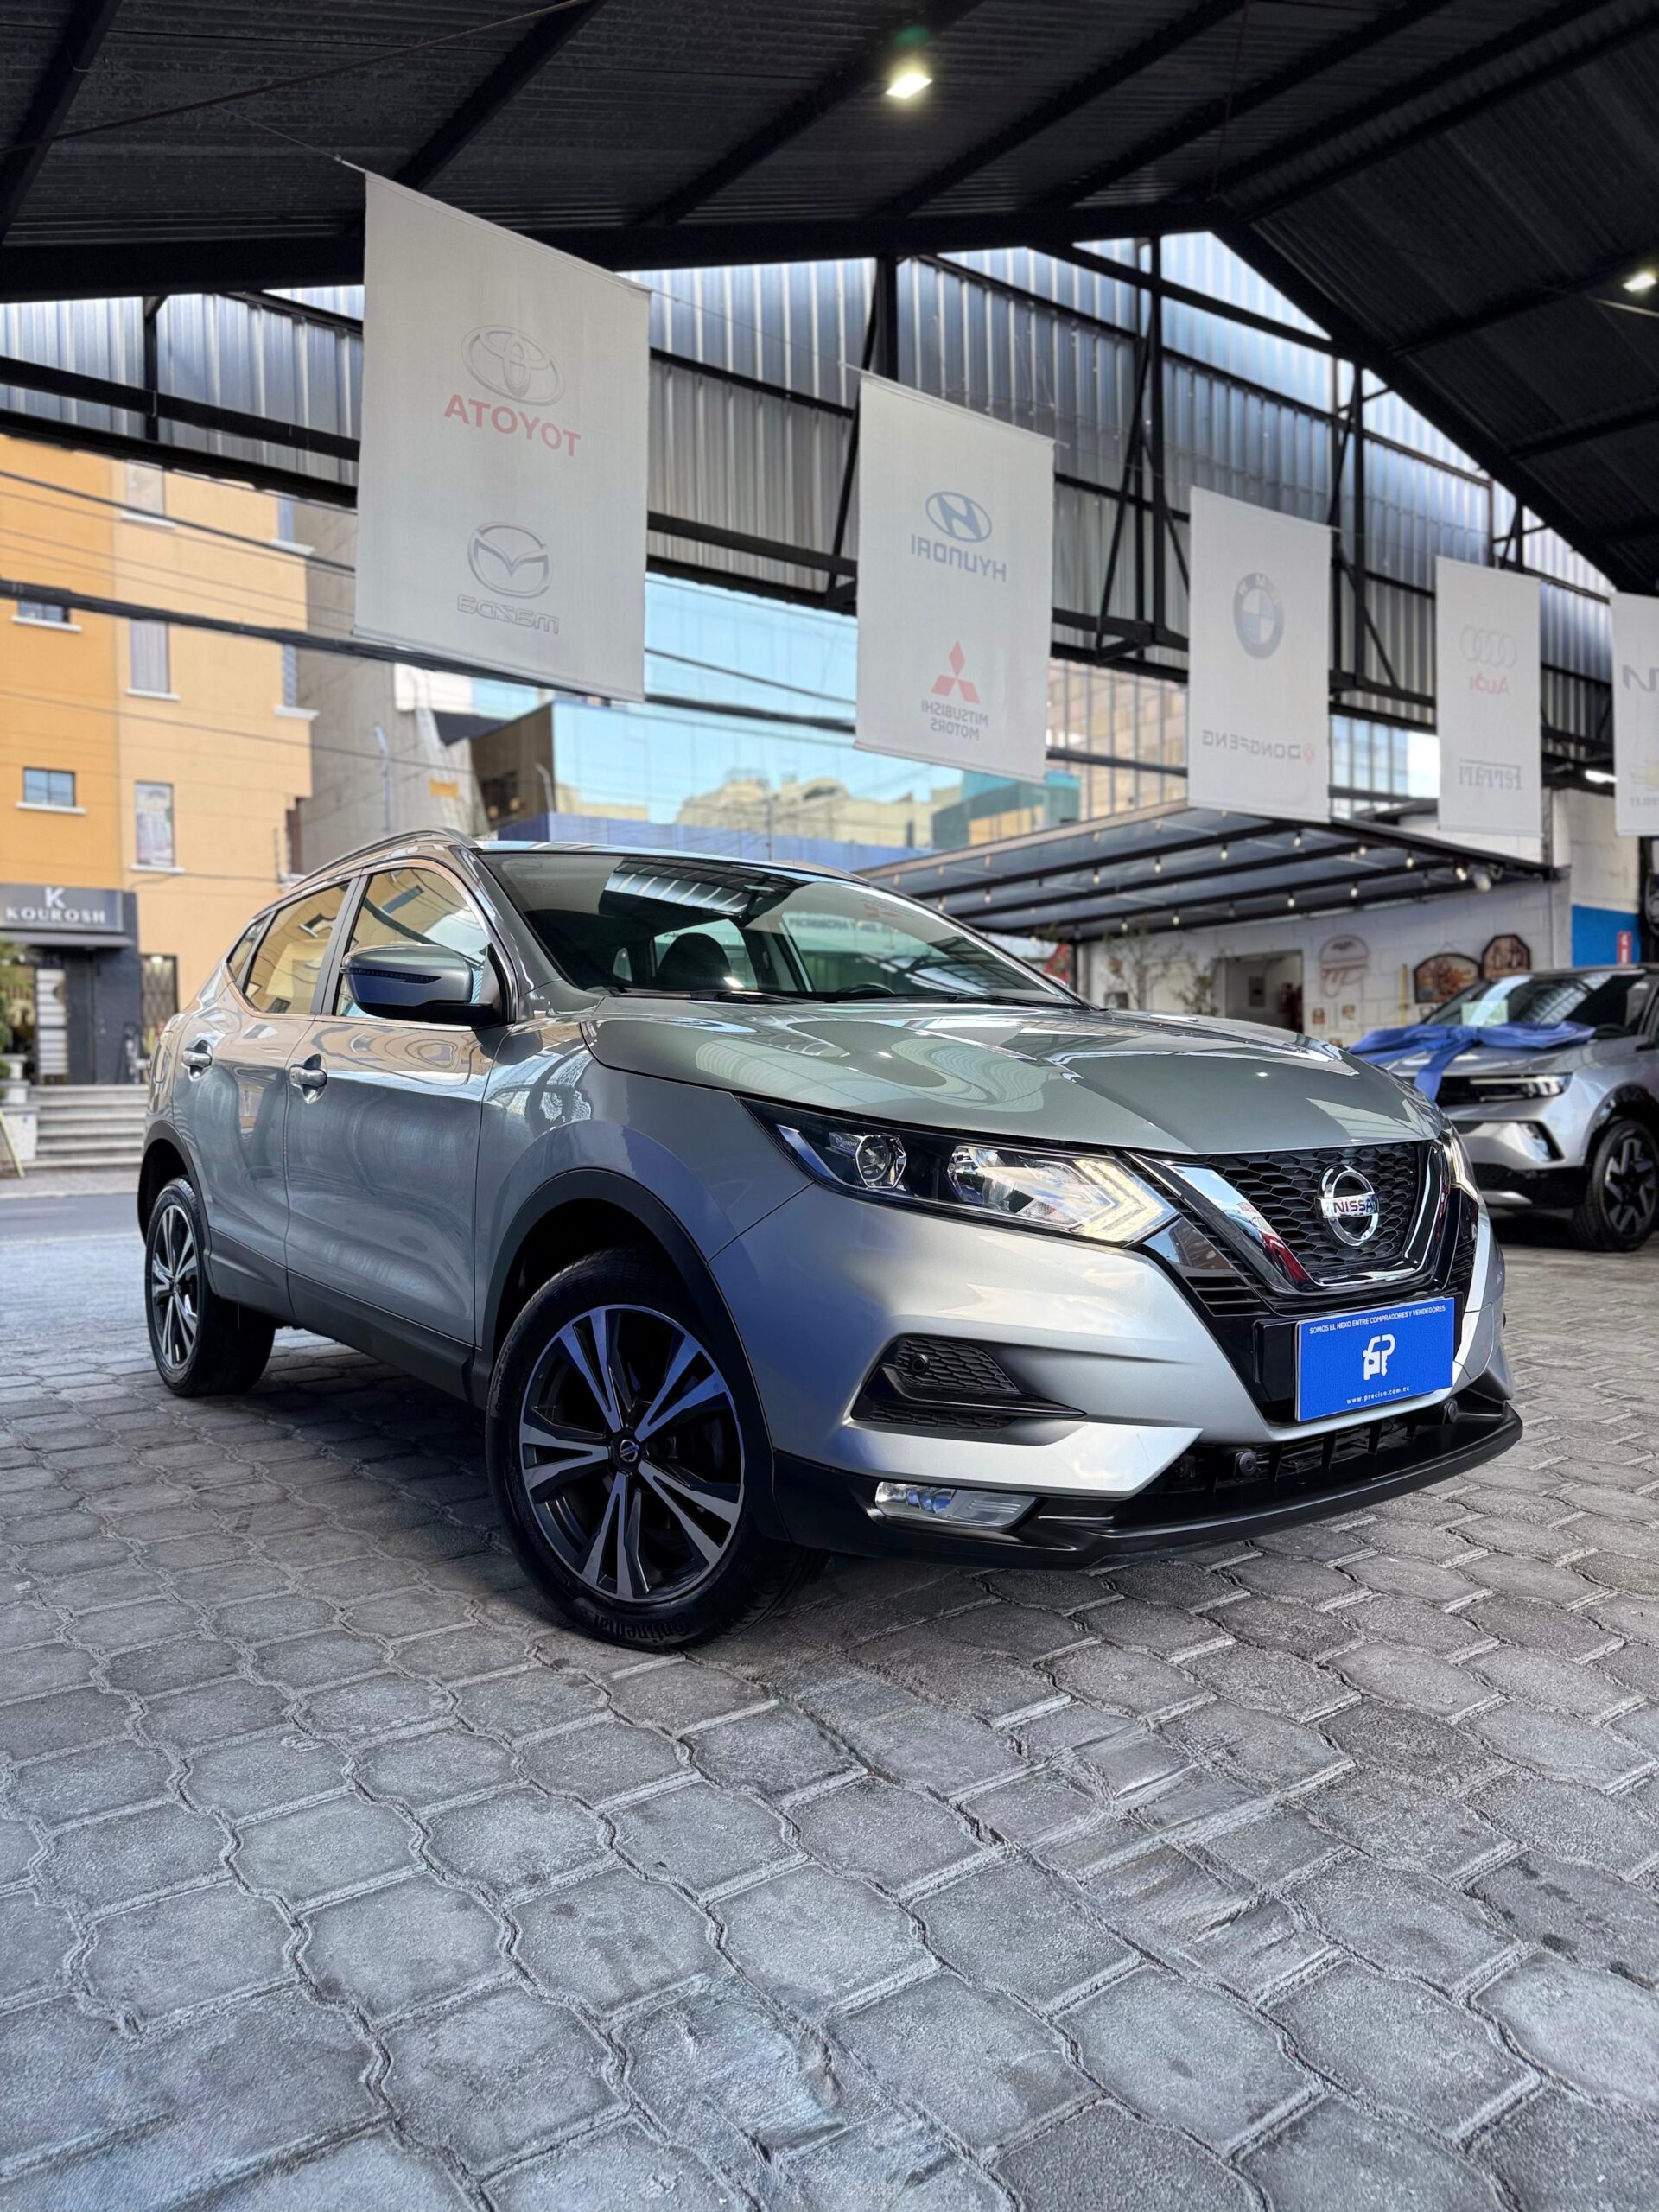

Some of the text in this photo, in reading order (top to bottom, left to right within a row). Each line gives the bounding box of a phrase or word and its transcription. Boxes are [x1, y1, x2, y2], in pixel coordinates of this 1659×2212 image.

[45, 887, 67, 909] K
[5, 906, 106, 925] KOUROSH
[1309, 1324, 1329, 1334] SOMOS
[1337, 1320, 1352, 1330] NEXO
[1351, 1318, 1370, 1327] ENTRE
[1370, 1311, 1408, 1324] COMPRADORES
[1412, 1305, 1446, 1317] VENDEDORES
[1346, 1385, 1410, 1404] www.preciso.com.ec
